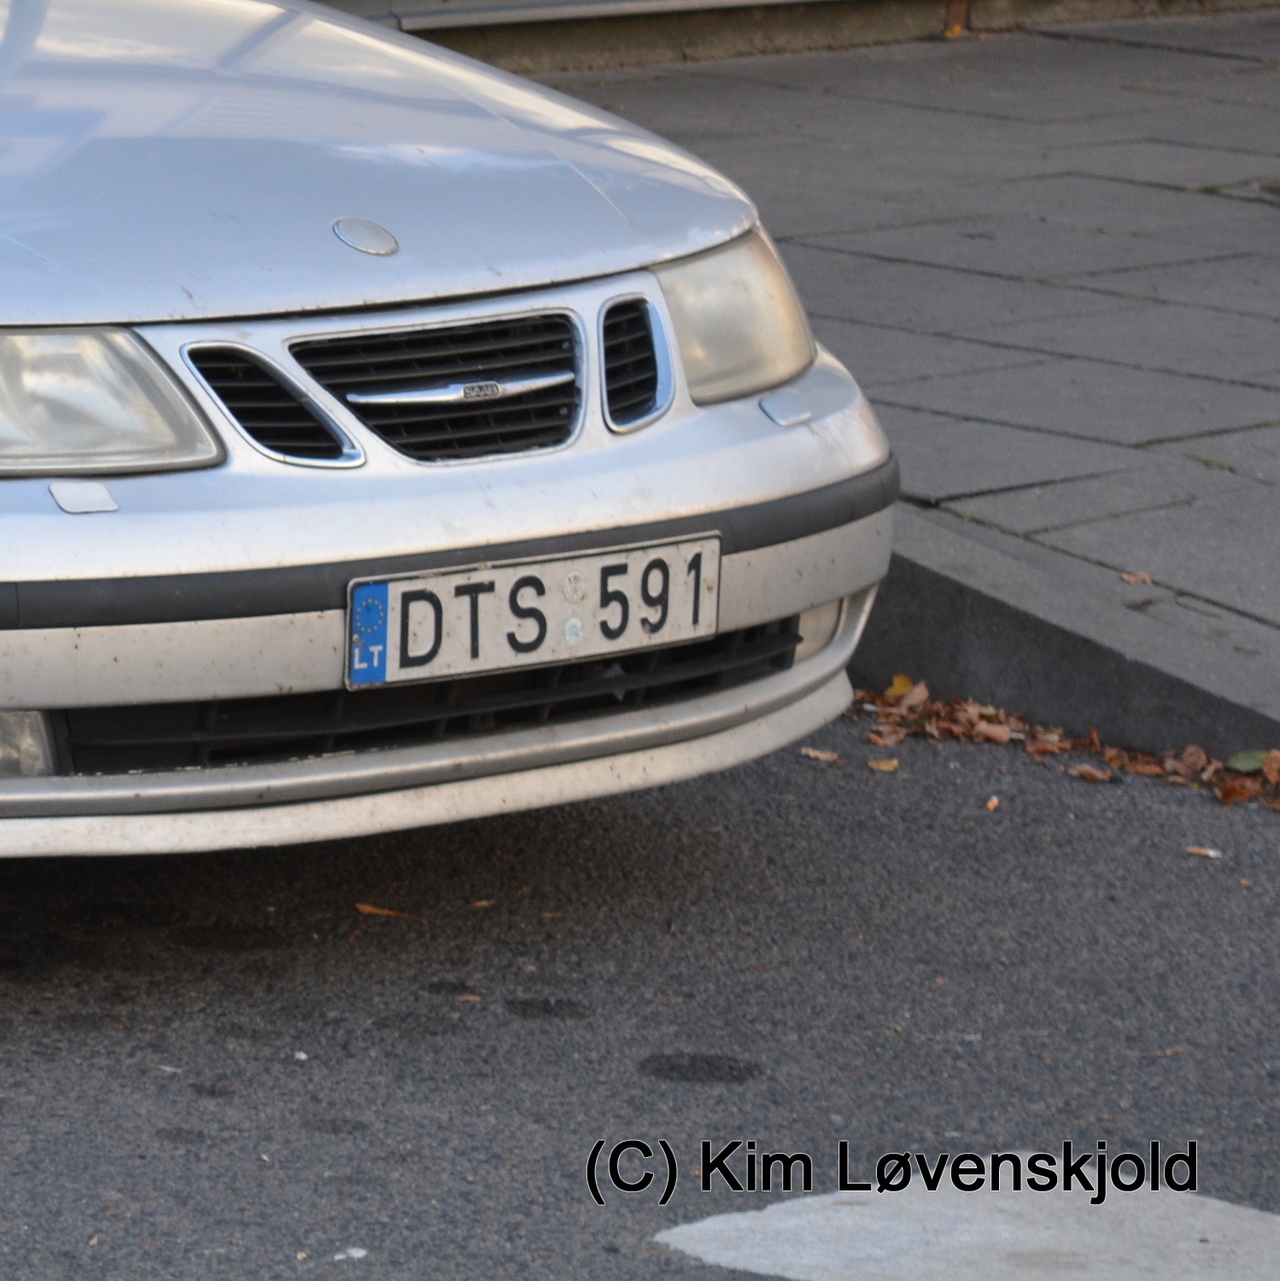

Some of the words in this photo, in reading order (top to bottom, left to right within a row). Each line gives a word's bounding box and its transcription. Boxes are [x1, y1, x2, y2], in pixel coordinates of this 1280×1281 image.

[354, 645, 383, 669] LT
[399, 575, 547, 669] DTS
[600, 552, 702, 640] 591
